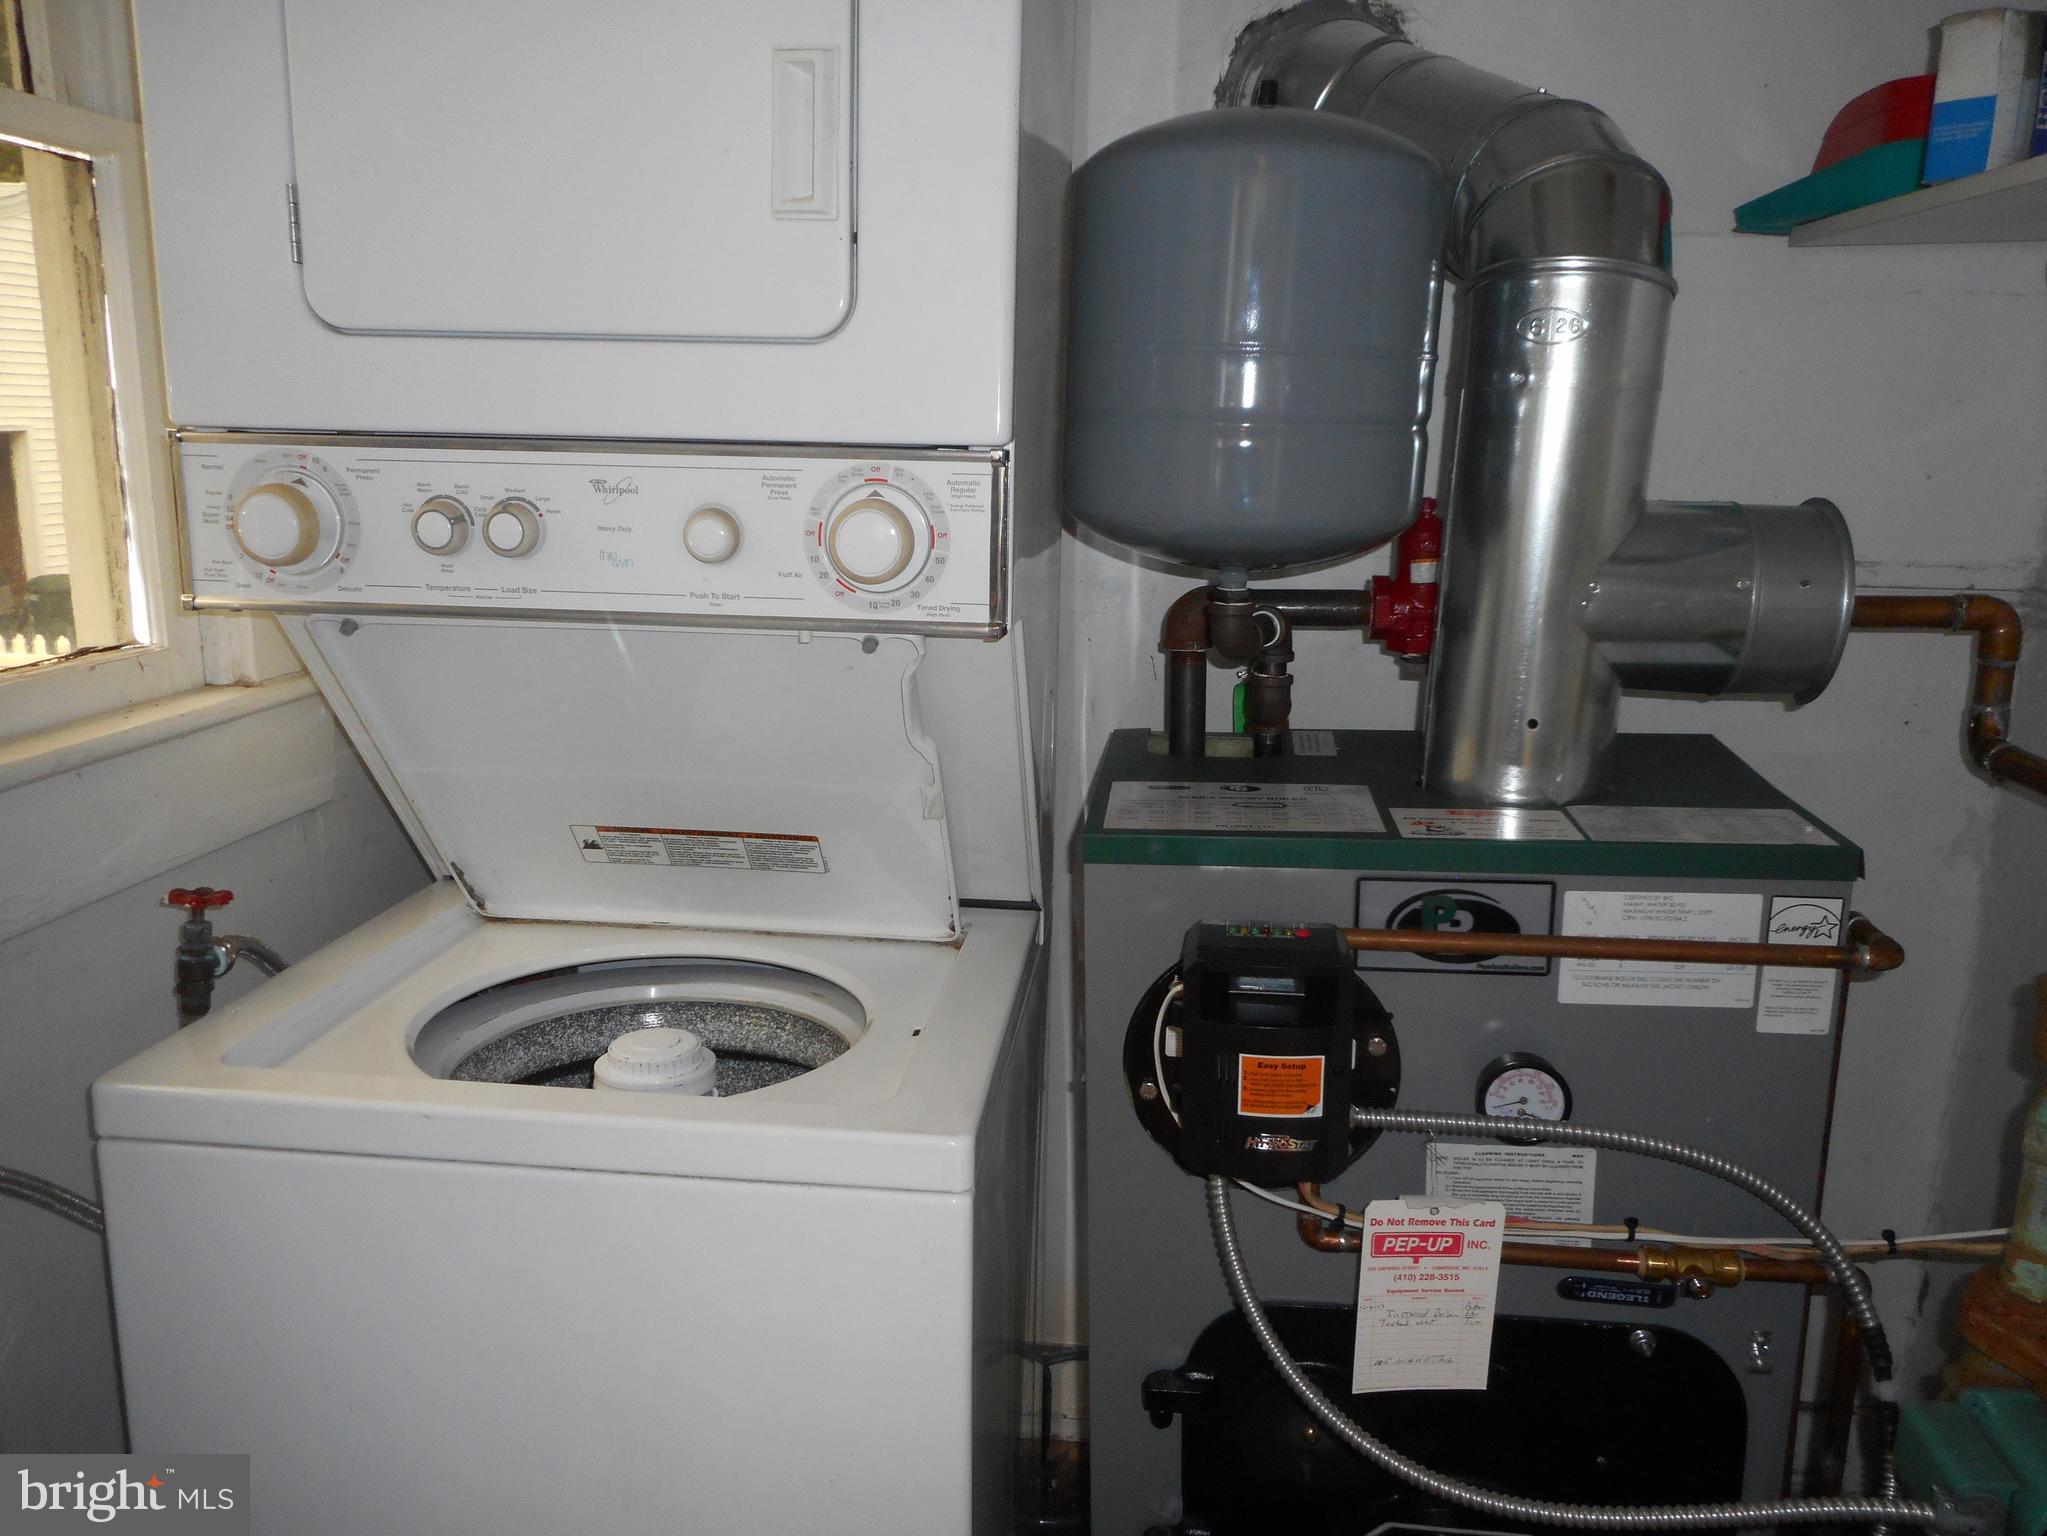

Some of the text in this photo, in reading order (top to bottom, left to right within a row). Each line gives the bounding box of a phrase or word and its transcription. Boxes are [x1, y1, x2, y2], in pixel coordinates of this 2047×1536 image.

[1556, 317, 1580, 334] 26
[346, 467, 380, 475] Permanent
[761, 475, 796, 483] Automatic
[946, 479, 981, 487] Automatic
[592, 484, 639, 498] Whirlpool
[950, 486, 977, 494] Regular
[535, 495, 551, 503] Large
[597, 525, 615, 533] Heavy
[935, 557, 945, 565] 50
[819, 571, 829, 579] 20
[425, 584, 471, 592] Temperature
[689, 592, 708, 600] Push
[721, 593, 741, 601] Start
[910, 591, 920, 599] 30
[917, 604, 961, 613] Timed Drying
[1257, 1062, 1307, 1070] Easy Setup
[1369, 1218, 1496, 1228] Do Not Remove This Card
[1382, 1237, 1491, 1252] PEP-UP INC.
[1393, 1273, 1461, 1283] (410) 228-3515
[1587, 1290, 1644, 1304] LEGEND
